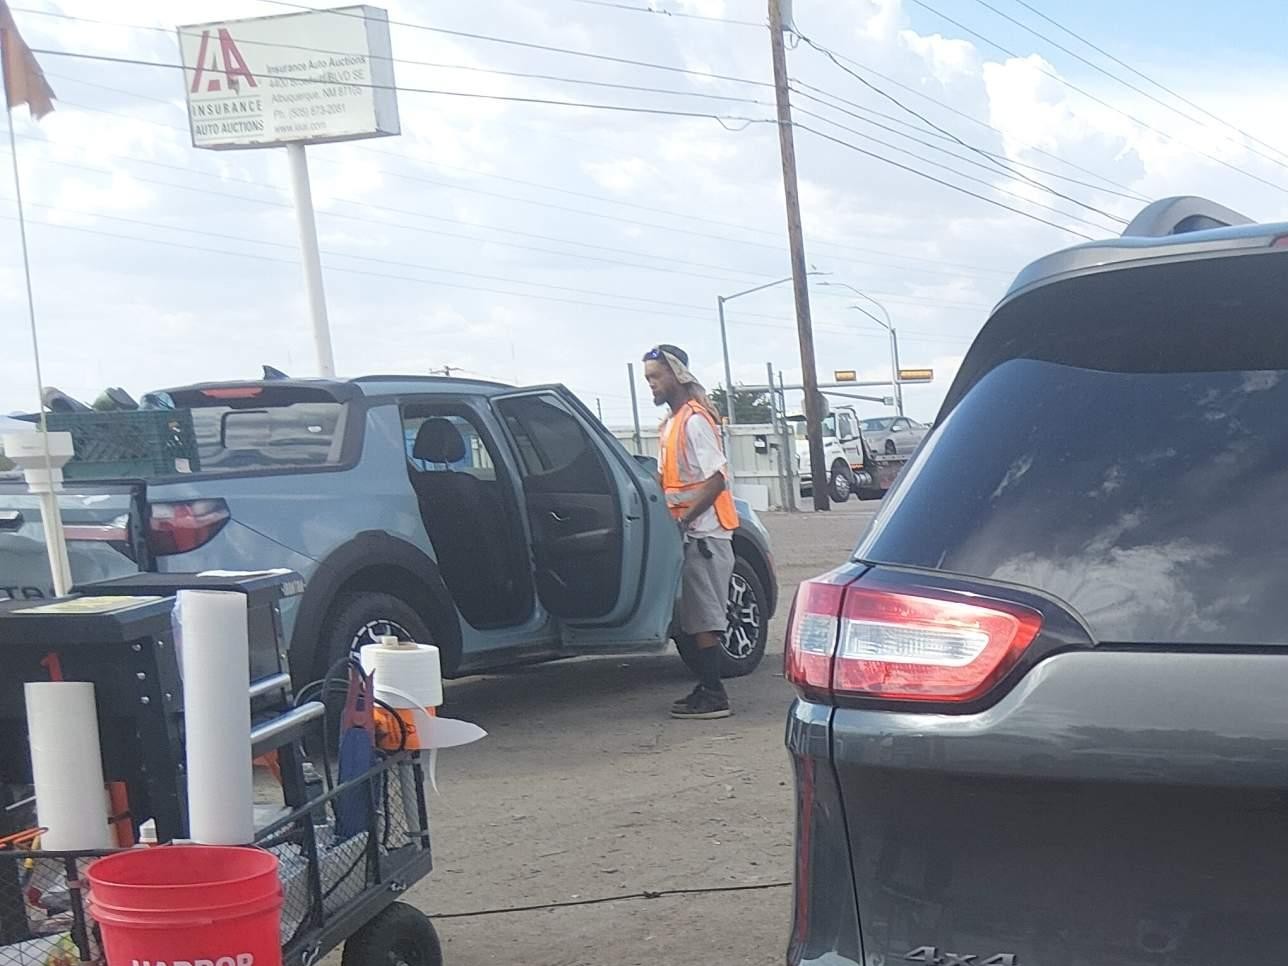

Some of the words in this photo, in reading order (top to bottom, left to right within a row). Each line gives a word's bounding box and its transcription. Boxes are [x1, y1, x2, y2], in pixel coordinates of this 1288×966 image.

[308, 59, 327, 70] Auto
[329, 55, 367, 68] Auctions
[192, 100, 263, 117] INSURANCE
[195, 121, 220, 136] AUTO
[221, 119, 265, 134] AUCTIONS
